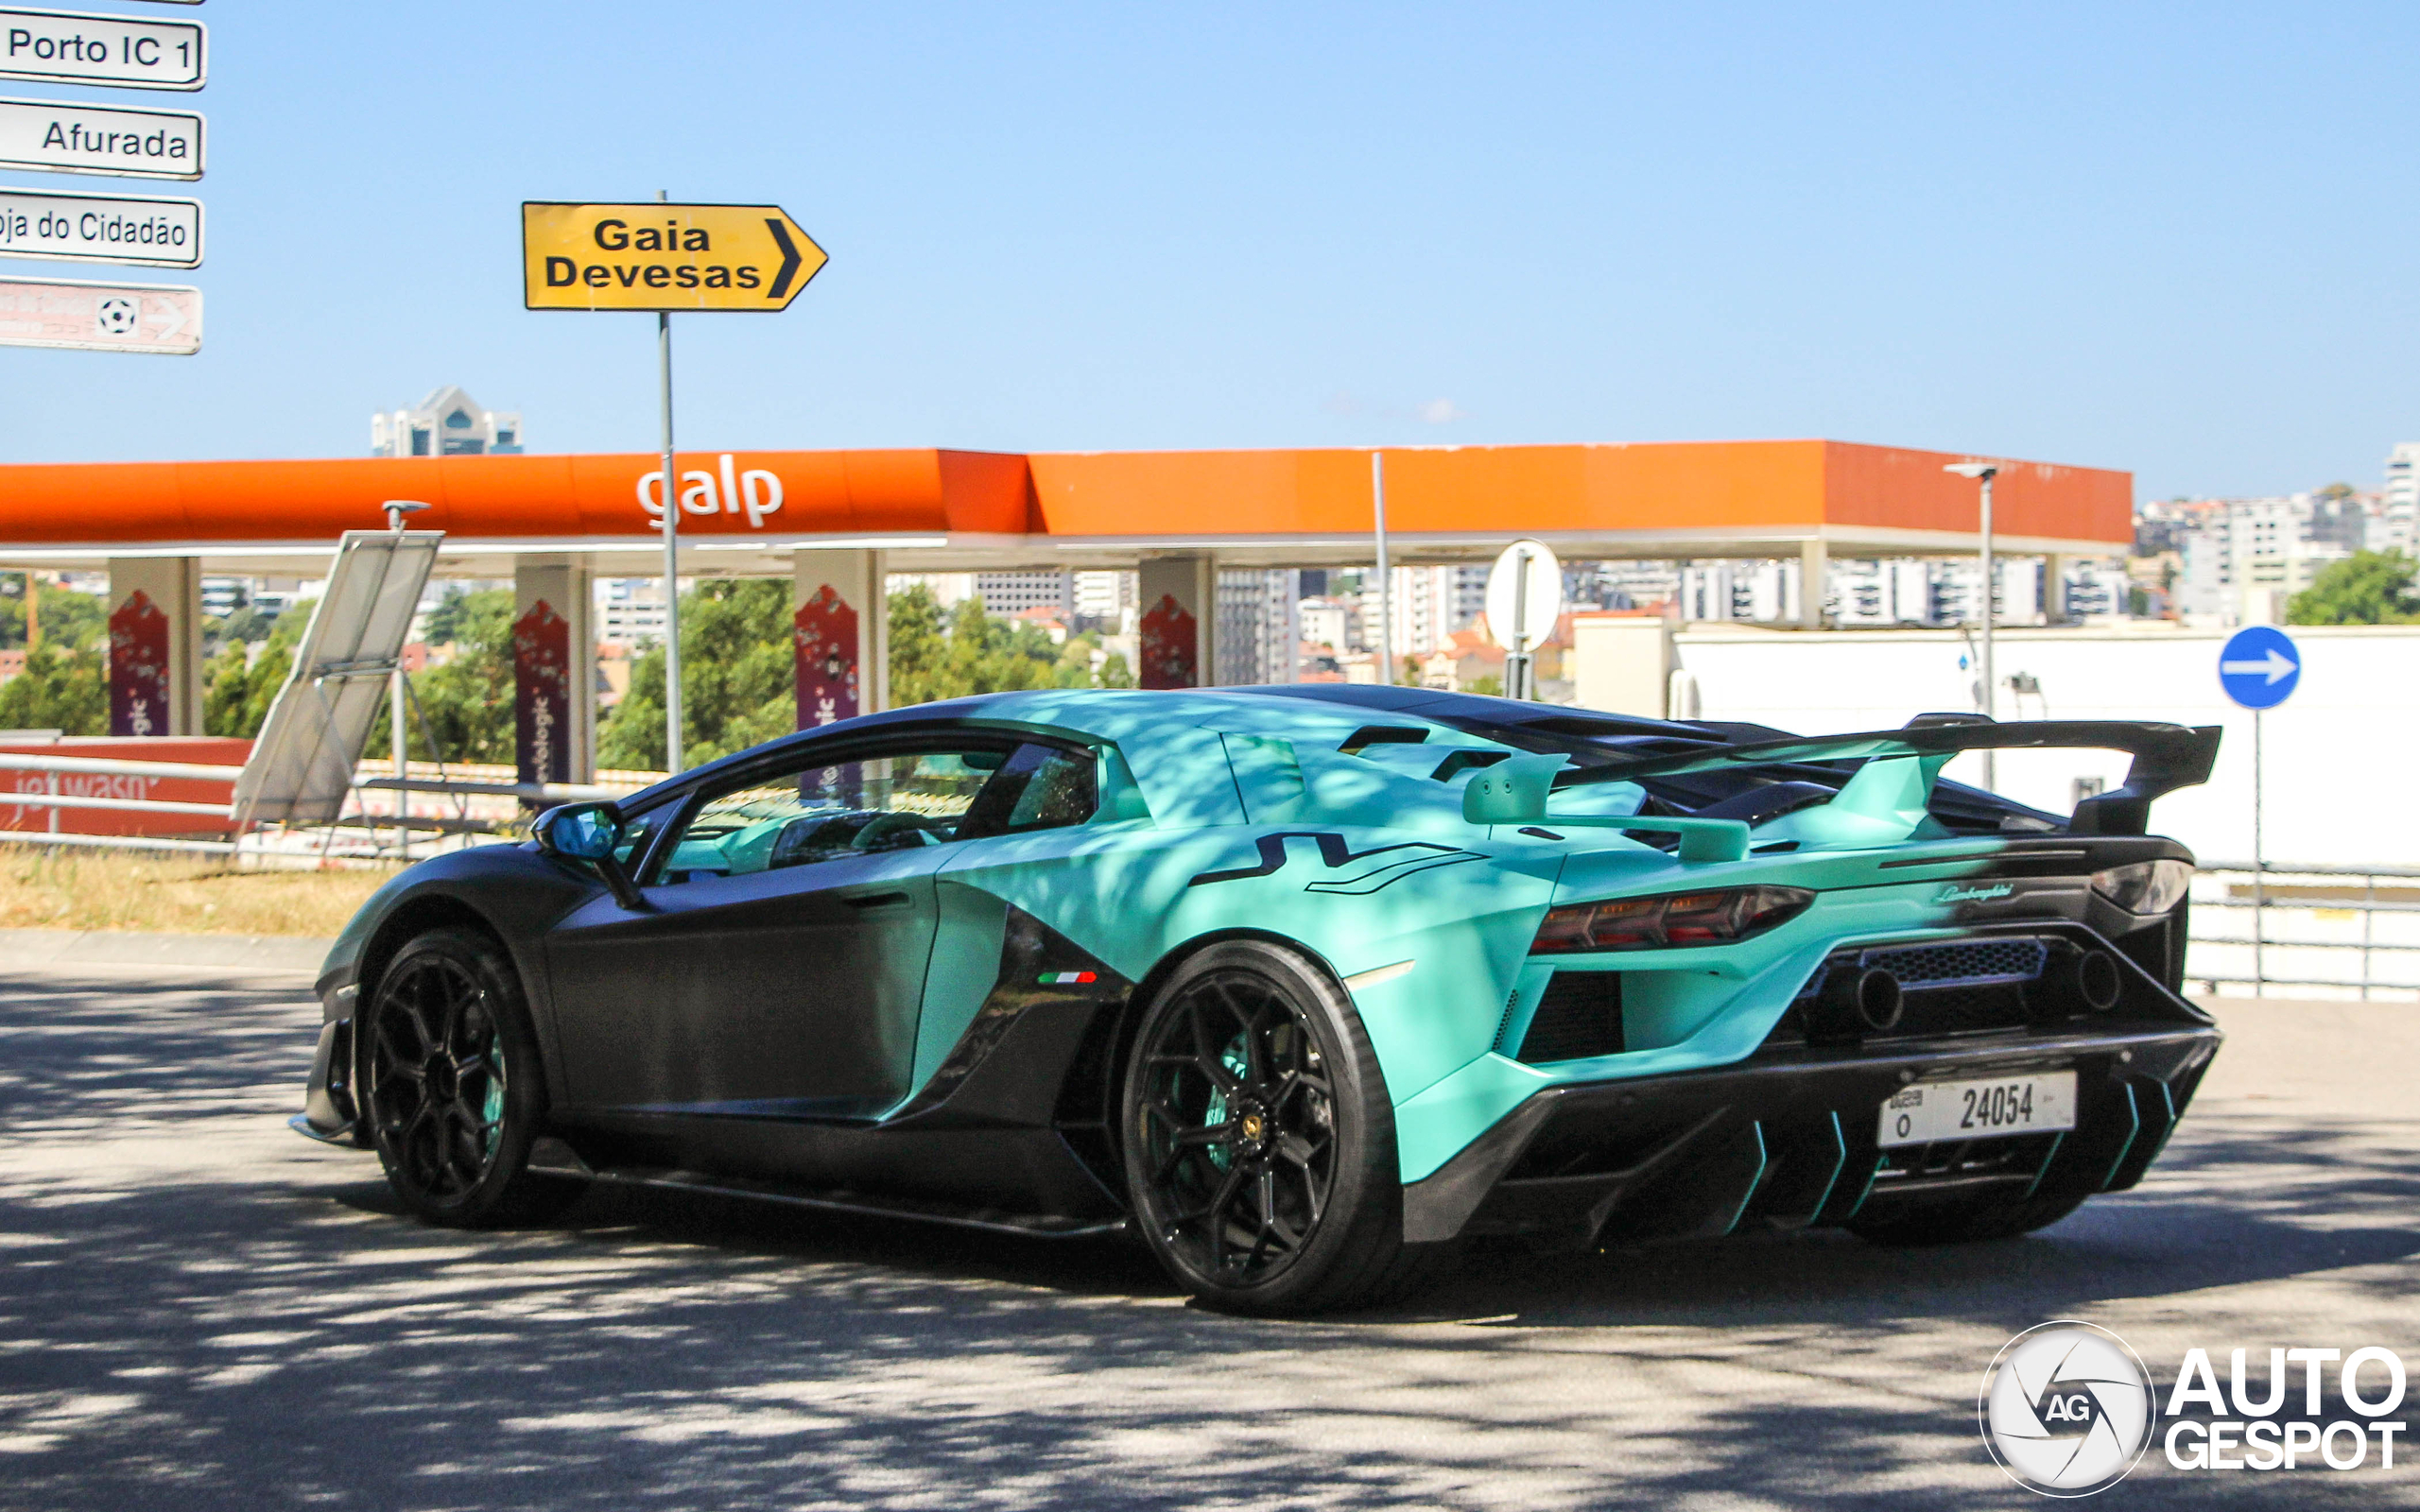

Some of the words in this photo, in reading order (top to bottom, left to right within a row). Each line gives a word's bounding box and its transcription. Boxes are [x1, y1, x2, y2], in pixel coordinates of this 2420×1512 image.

[9, 28, 108, 63] Porto
[123, 36, 160, 66] IC
[177, 42, 189, 68] 1
[43, 121, 188, 159] Afurada
[39, 210, 69, 239] do
[80, 212, 186, 247] Cidadão
[594, 218, 711, 251] Gaia
[545, 255, 762, 289] Devesas
[636, 454, 785, 529] galp
[1960, 1084, 2033, 1129] 24054
